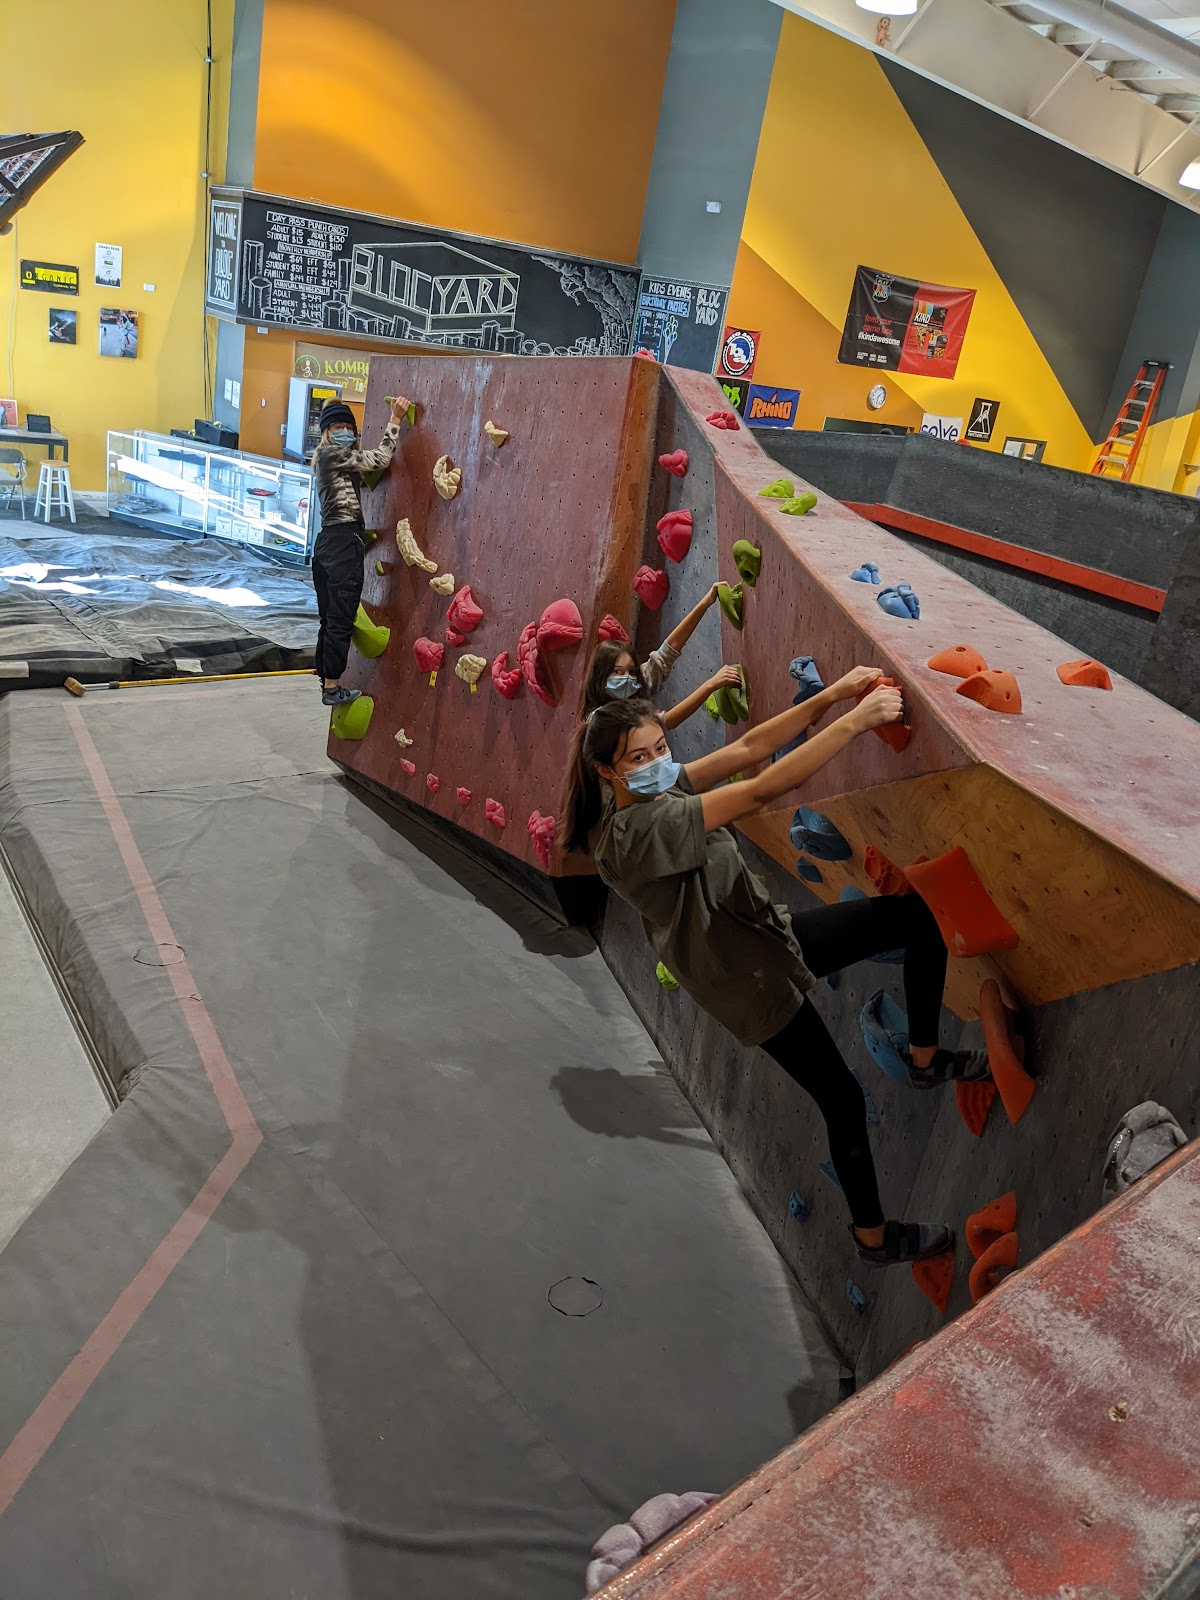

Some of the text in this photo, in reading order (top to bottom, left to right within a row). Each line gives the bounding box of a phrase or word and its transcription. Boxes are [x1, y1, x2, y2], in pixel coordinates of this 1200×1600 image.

[214, 211, 237, 240] WELCOME
[272, 213, 287, 224] DAY
[288, 217, 305, 227] PASS
[271, 224, 304, 236] ADULT $15
[266, 231, 304, 245] STUDENT $13
[311, 232, 345, 244] ADULT $130
[329, 243, 343, 252] $110
[268, 251, 336, 270] ADULT $69 EFT $59
[265, 260, 336, 278] STUDENT $59 EFT $49
[25, 271, 75, 284] ORGANIC
[264, 269, 284, 279] FAMILY
[306, 276, 318, 284] EFT
[321, 278, 338, 288] $129
[351, 247, 432, 314] BLOC
[433, 277, 520, 314] YARD
[649, 282, 665, 295] KIDS
[273, 289, 321, 303] ADULT $549
[697, 289, 721, 309] BLOC
[272, 298, 322, 312] STUDENT $449
[695, 306, 719, 326] YARD
[914, 312, 931, 323] KIND
[857, 331, 901, 346] #kindawesome
